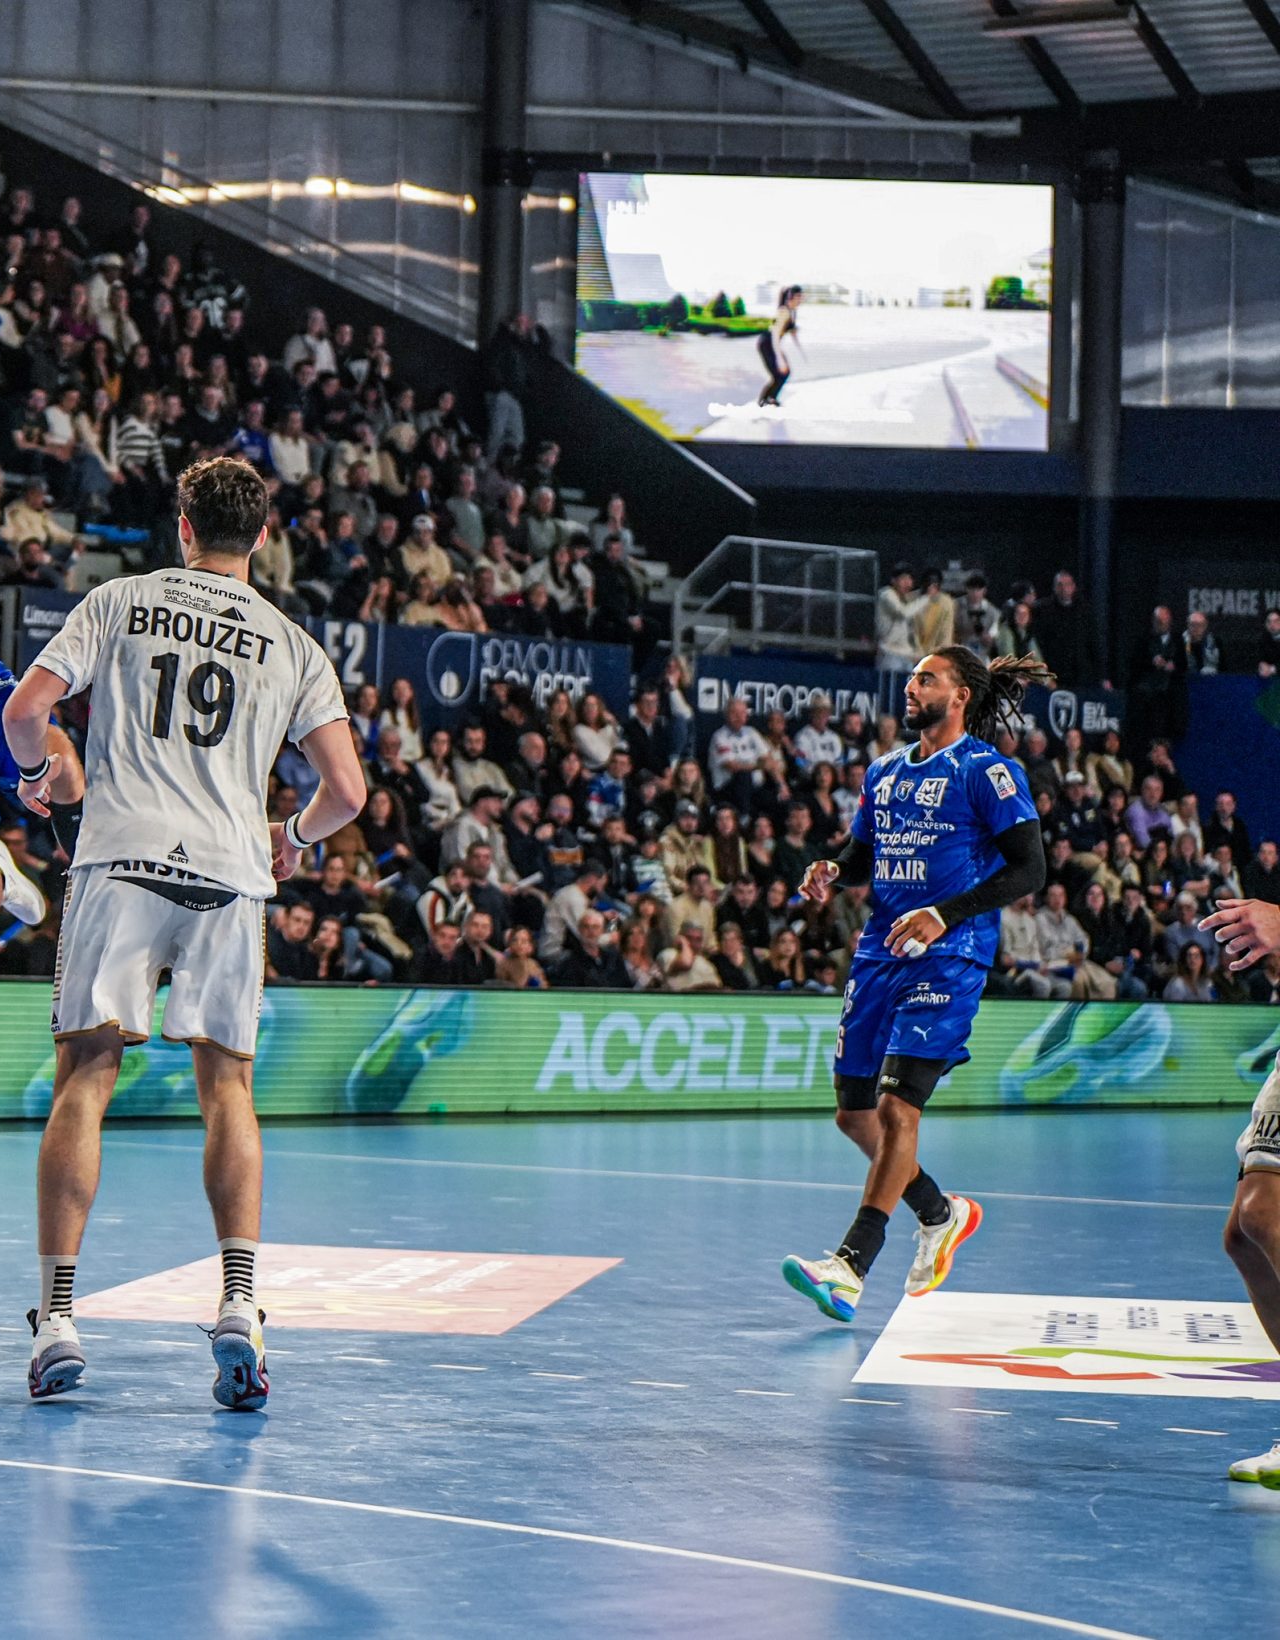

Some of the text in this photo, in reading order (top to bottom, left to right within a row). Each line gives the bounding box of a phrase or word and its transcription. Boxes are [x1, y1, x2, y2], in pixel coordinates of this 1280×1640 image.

[163, 588, 211, 606] GROUPE
[164, 594, 219, 614] MILANESIO
[189, 581, 251, 605] HYUNDAI
[128, 605, 274, 665] BROUZET
[150, 652, 235, 748] 19
[167, 854, 188, 864] SELECT
[891, 860, 926, 880] AIR
[835, 1024, 846, 1060] 6
